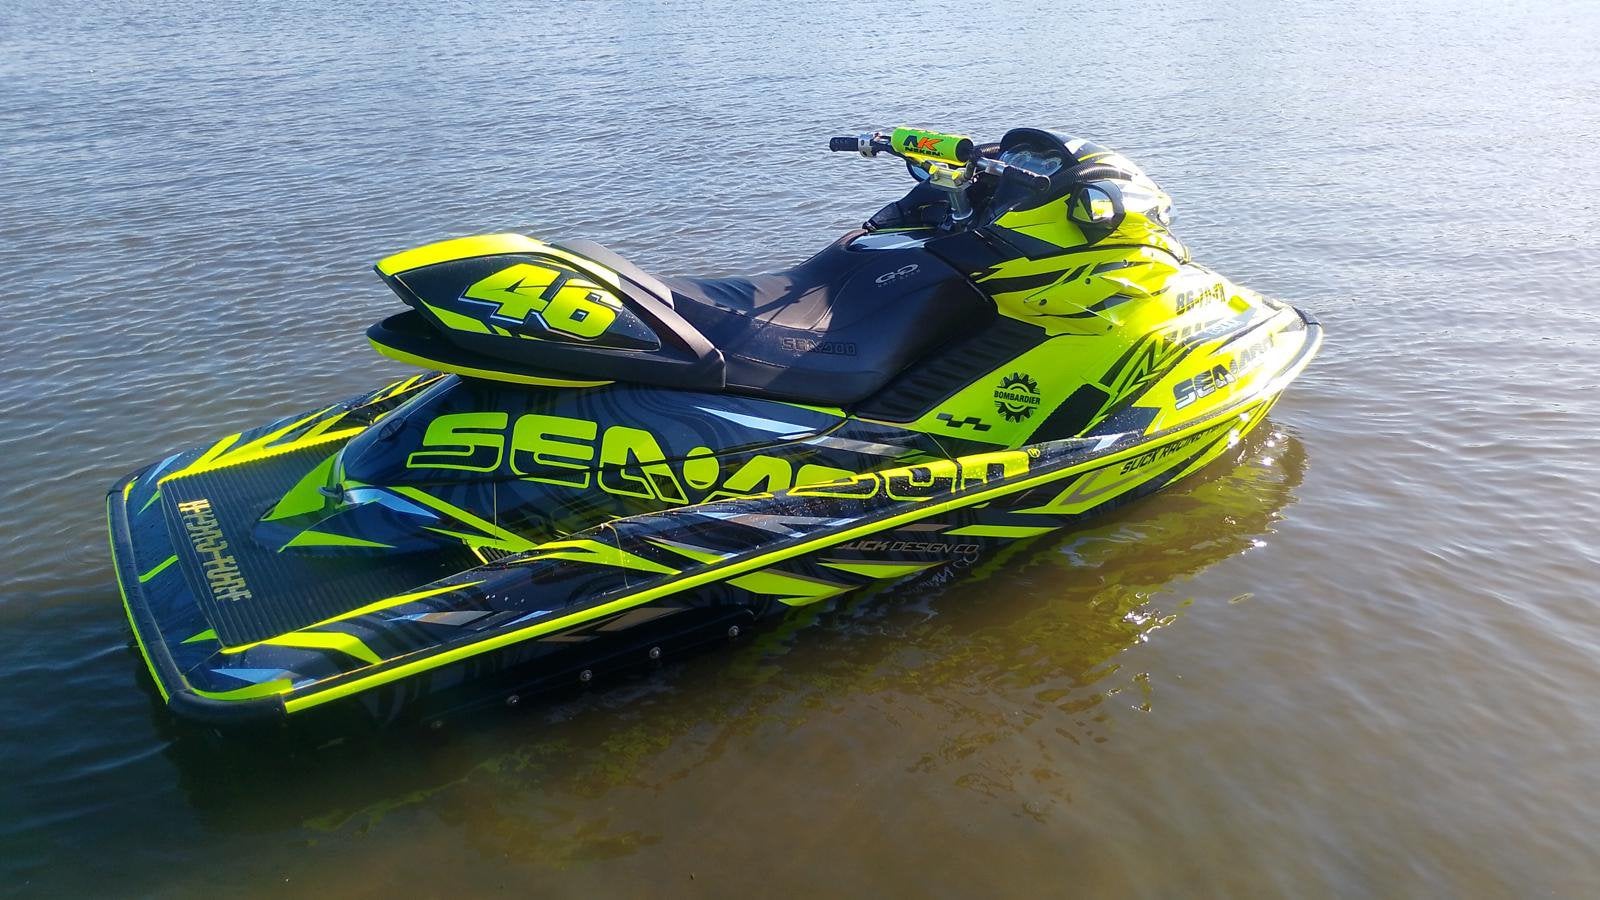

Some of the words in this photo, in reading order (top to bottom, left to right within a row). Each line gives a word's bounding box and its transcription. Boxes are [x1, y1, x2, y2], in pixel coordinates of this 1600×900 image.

[458, 263, 623, 339] 46
[993, 390, 1041, 405] BOMBARDIER
[1120, 449, 1159, 475] SLICK
[889, 541, 954, 553] DESIGN
[953, 543, 979, 554] CO
